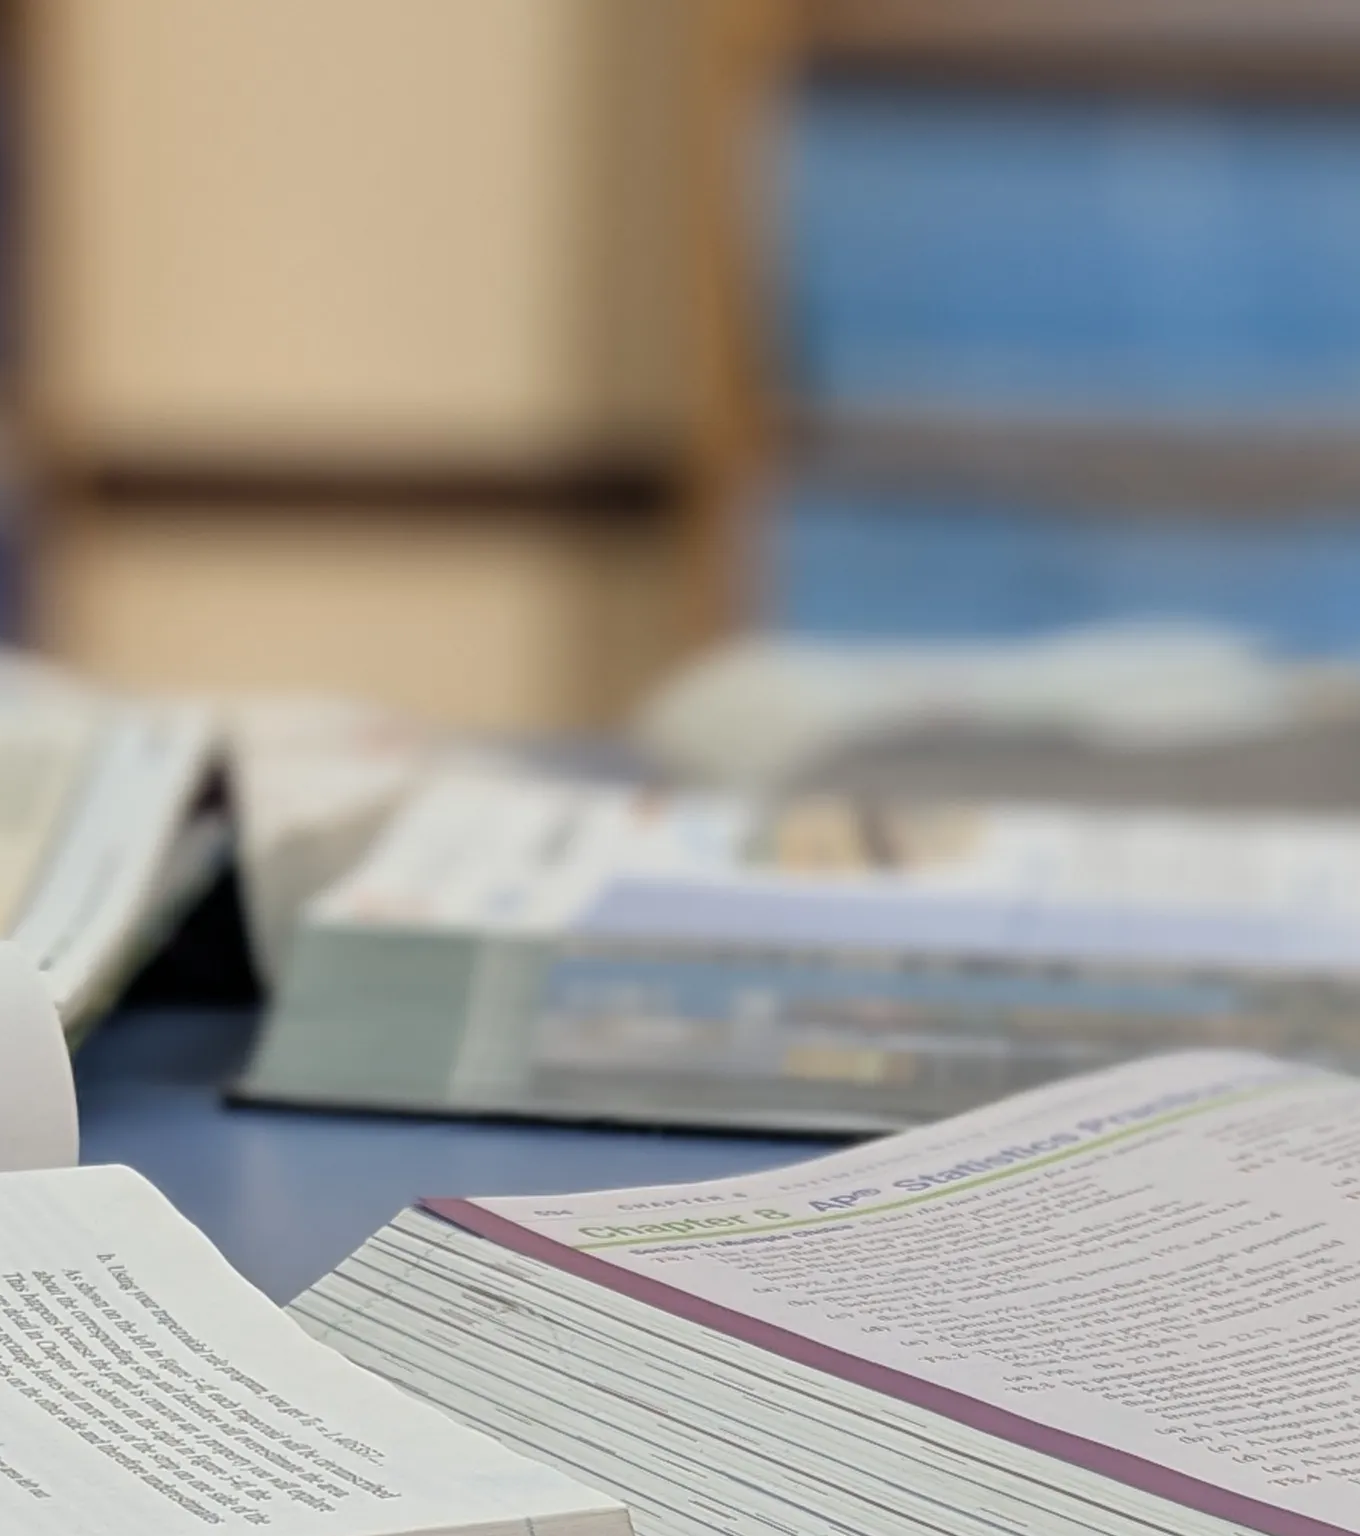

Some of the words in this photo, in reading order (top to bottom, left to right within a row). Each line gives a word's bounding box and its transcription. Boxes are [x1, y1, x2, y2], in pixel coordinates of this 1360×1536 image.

[578, 1213, 748, 1240] Chapter
[753, 1208, 791, 1222] 8
[893, 1132, 1080, 1193] Statistics
[2, 1272, 31, 1293] This
